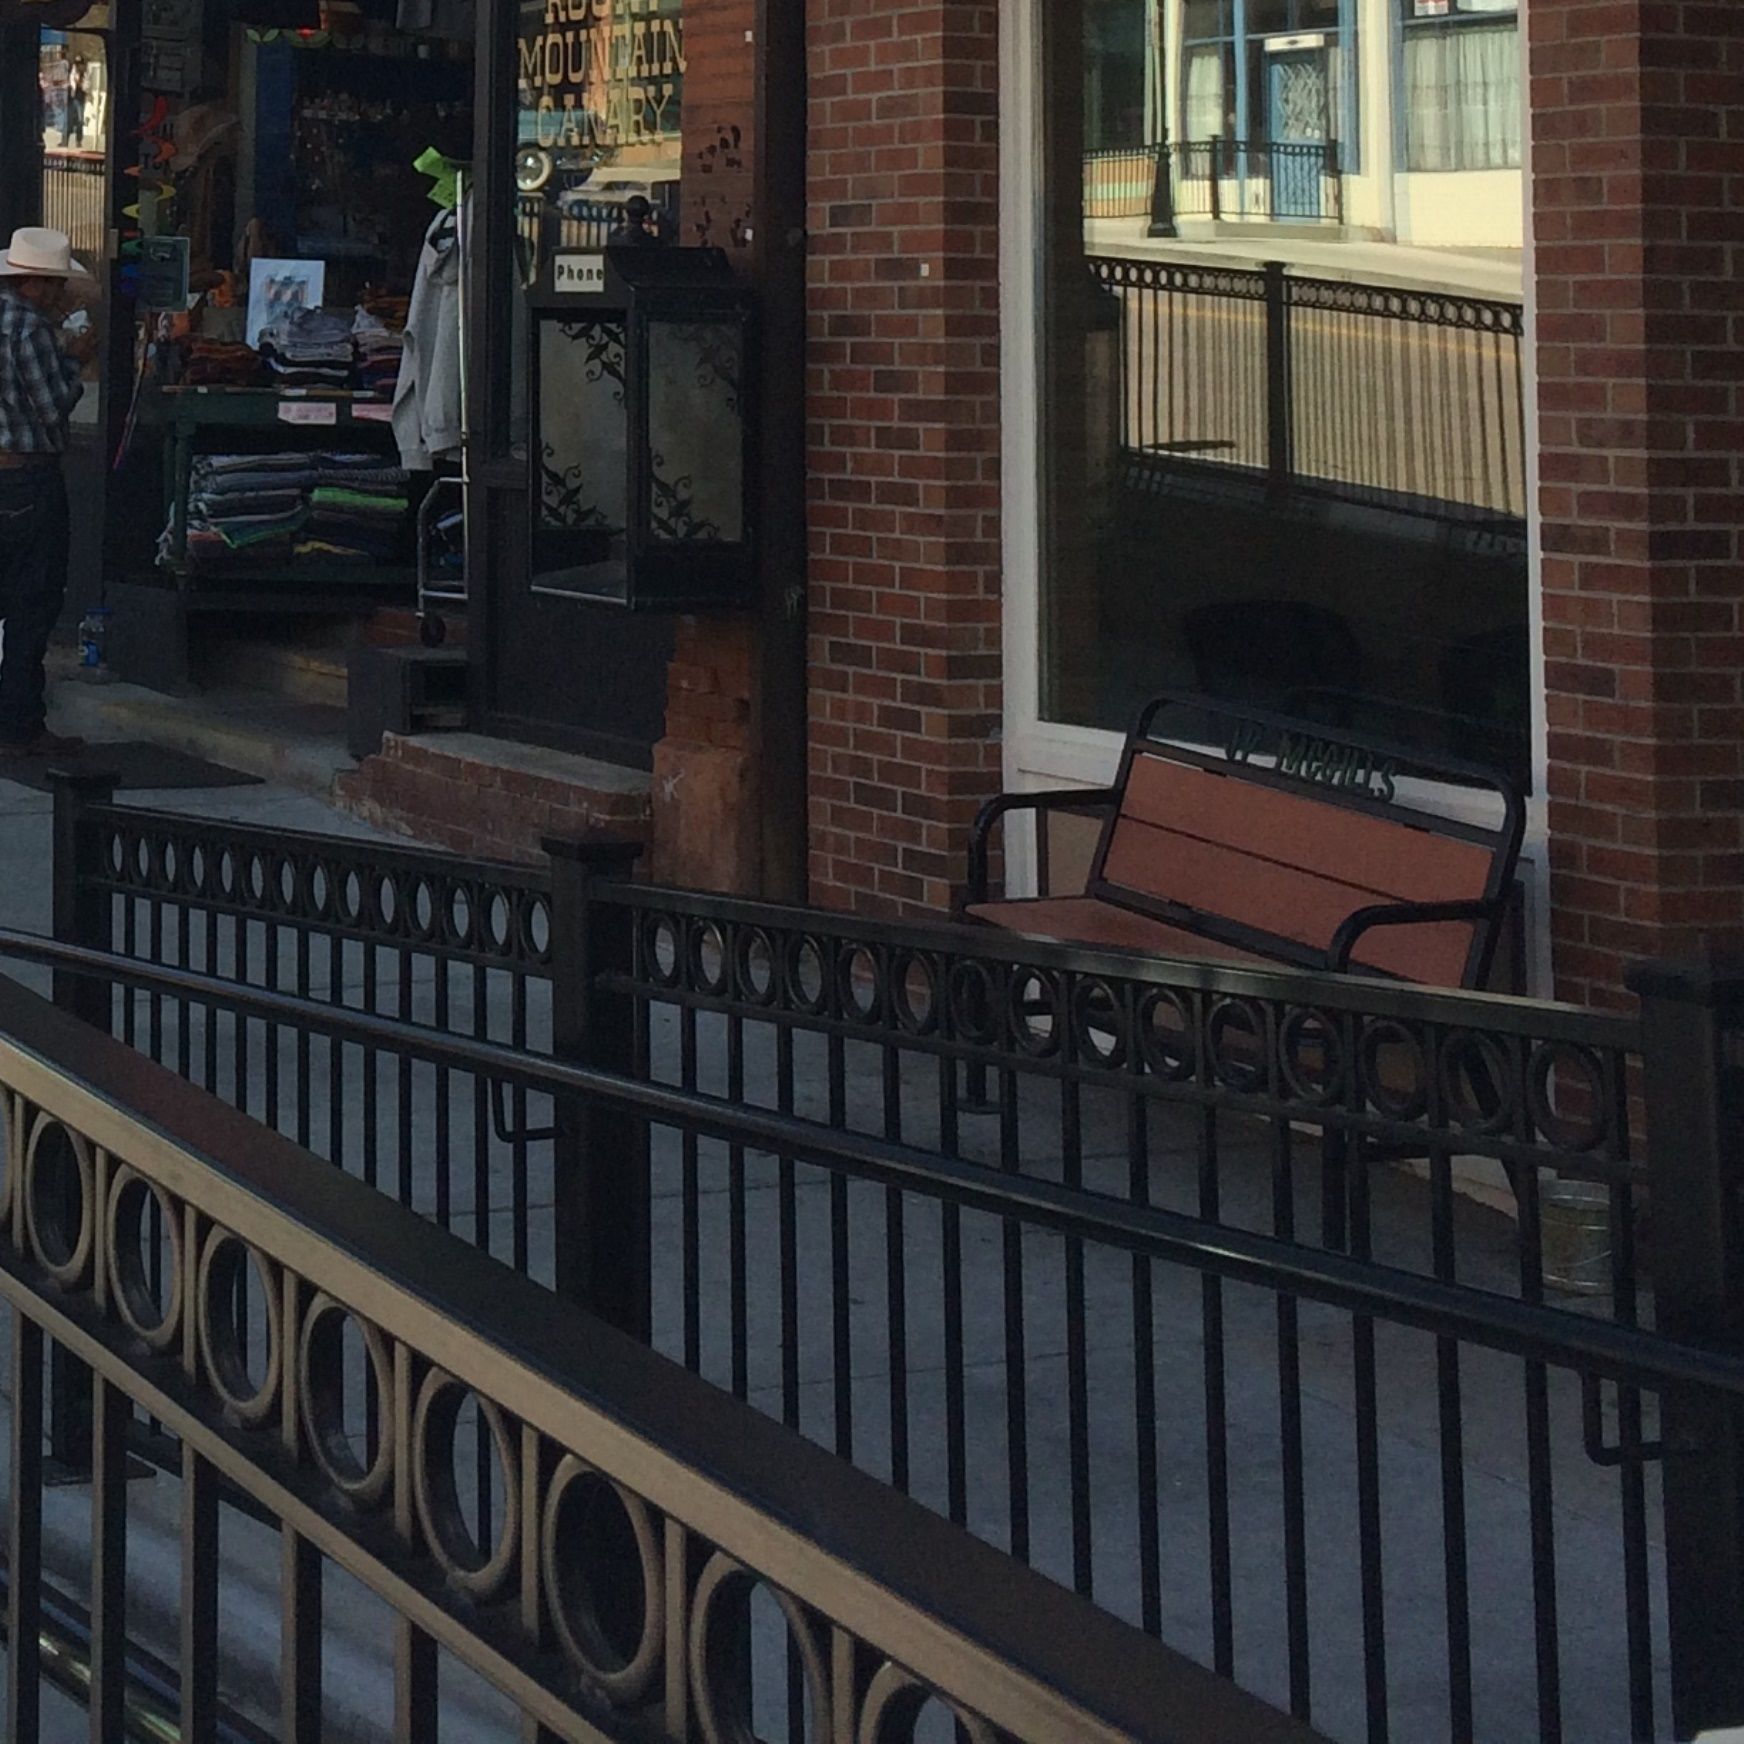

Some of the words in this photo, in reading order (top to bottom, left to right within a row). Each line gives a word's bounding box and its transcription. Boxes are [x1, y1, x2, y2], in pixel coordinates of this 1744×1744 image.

[518, 18, 687, 88] MOUNTAIN
[537, 83, 673, 148] CANARY
[557, 264, 604, 281] Phone
